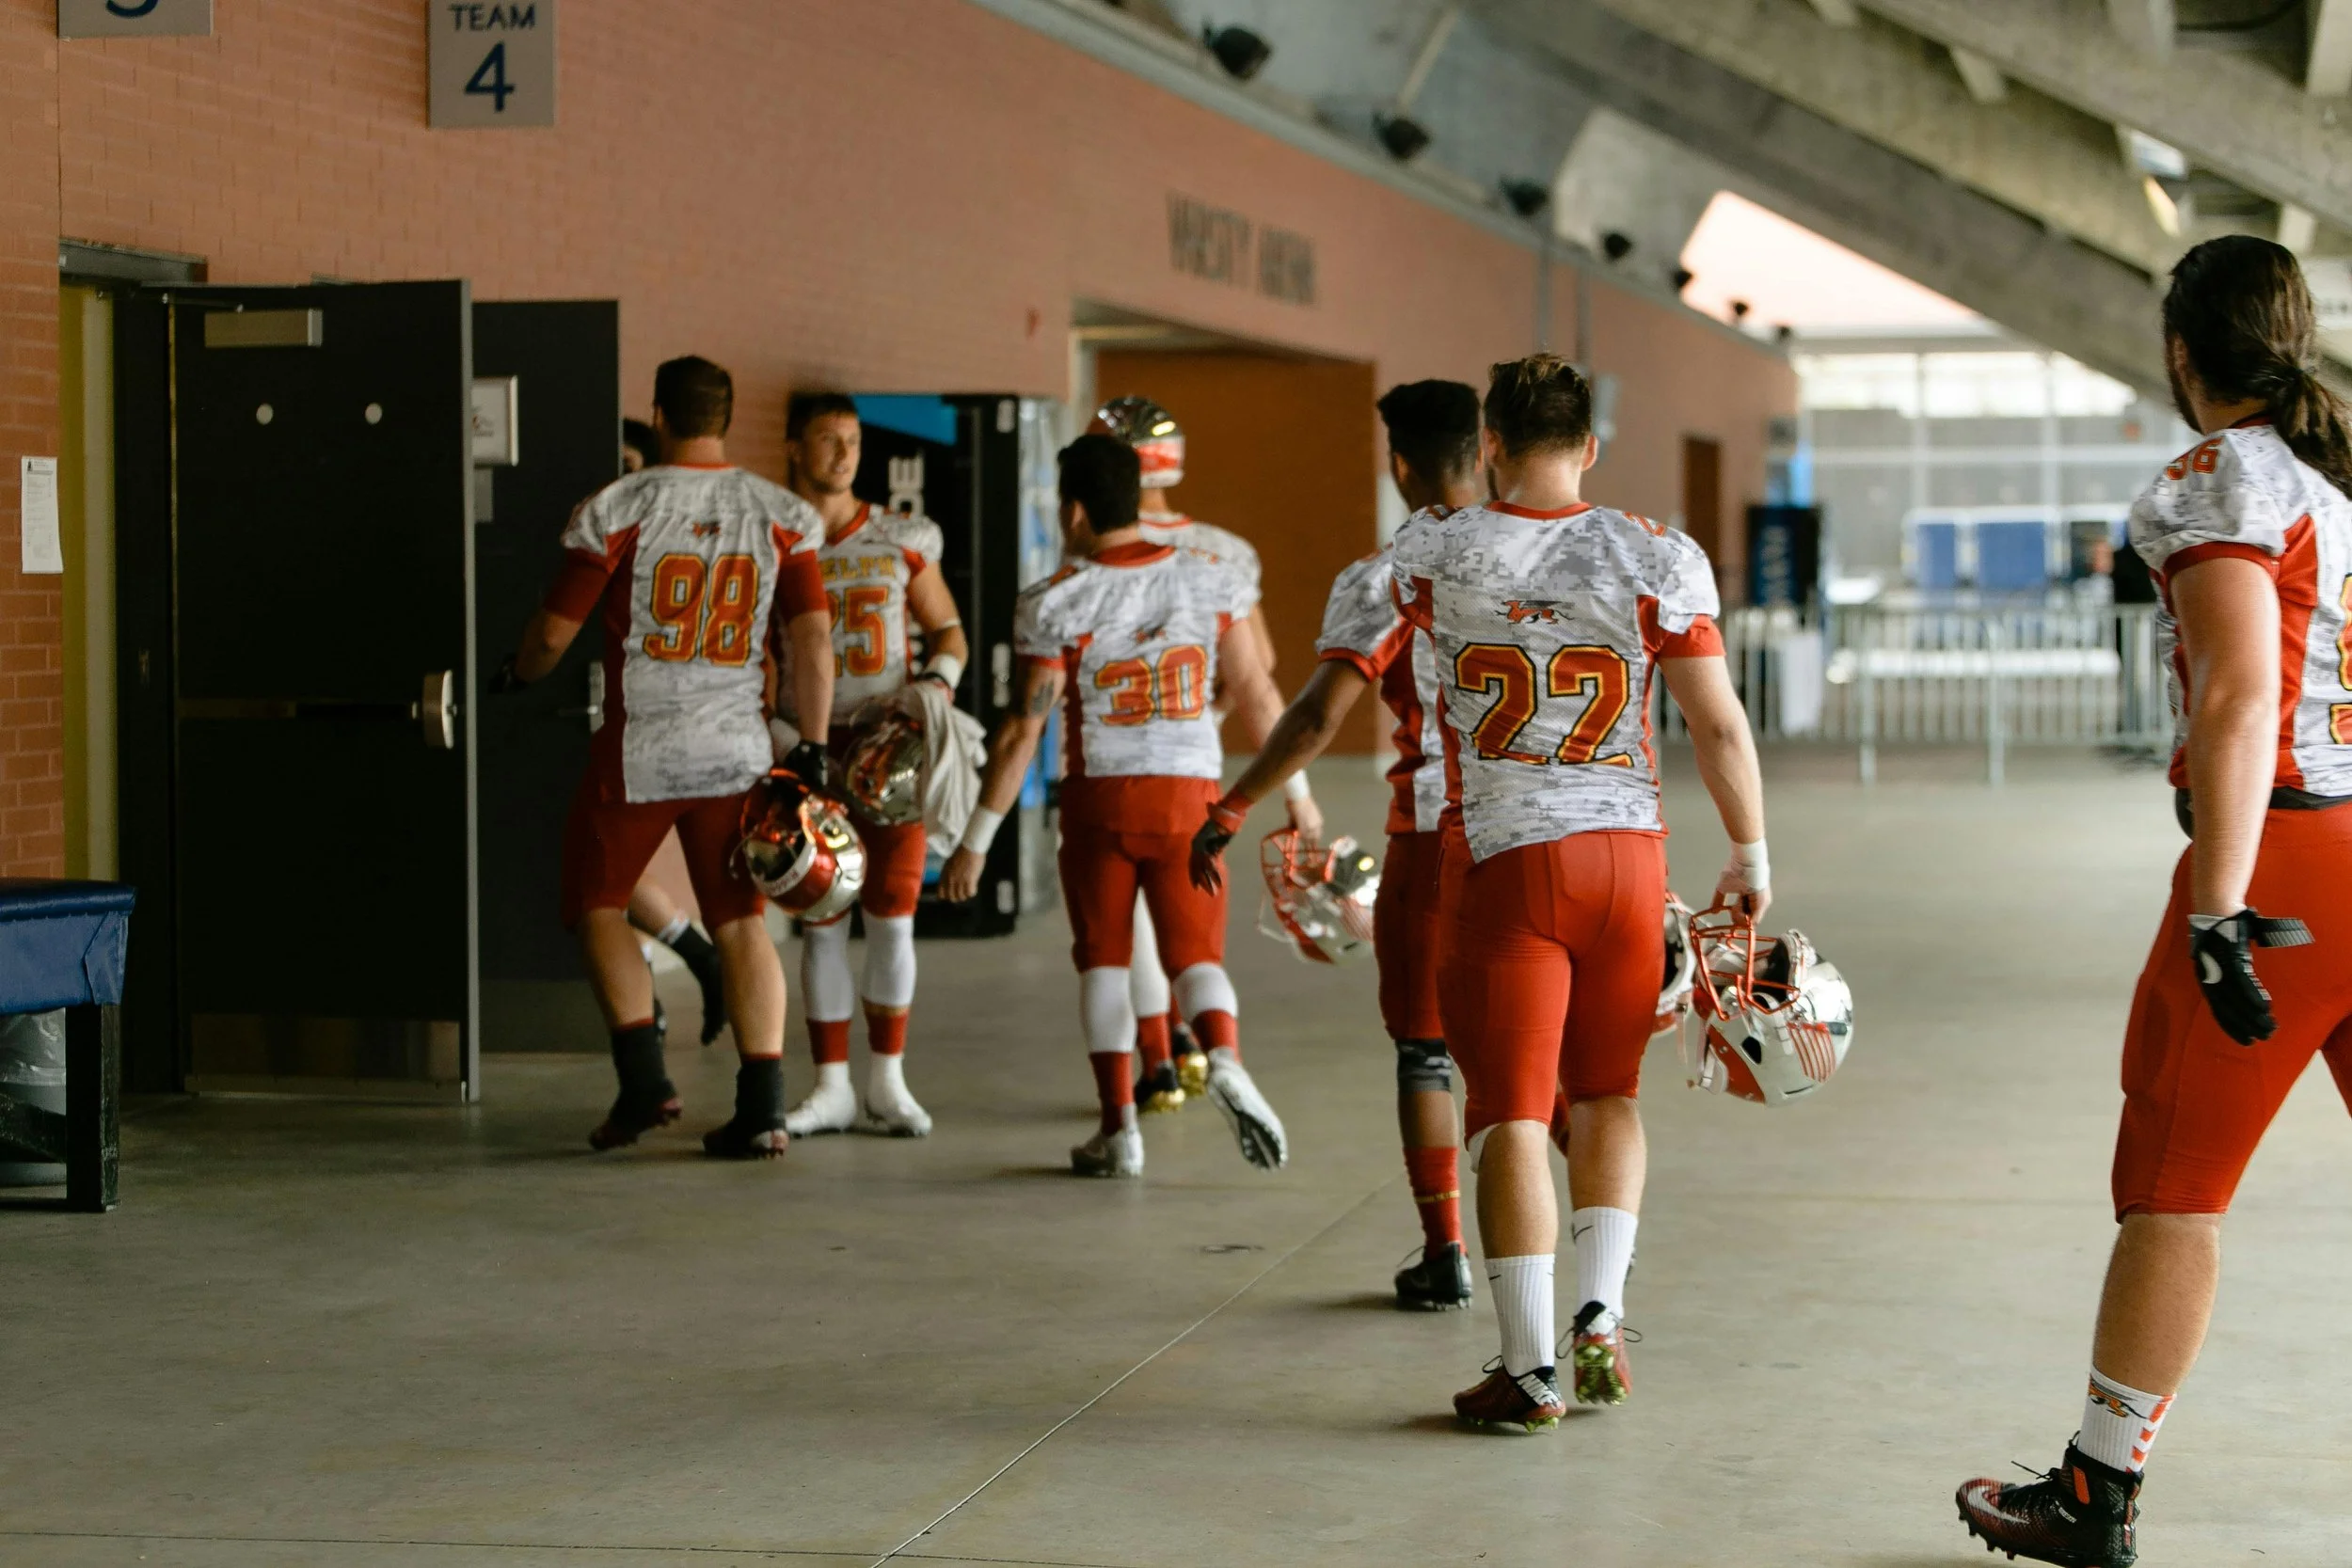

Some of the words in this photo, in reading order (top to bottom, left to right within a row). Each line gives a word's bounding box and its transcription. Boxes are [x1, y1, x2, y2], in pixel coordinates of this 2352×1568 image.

[448, 3, 536, 31] TEAM
[465, 41, 516, 113] 4
[820, 556, 898, 580] ELPH
[644, 553, 759, 668] 98
[1095, 644, 1208, 726] 30
[1454, 641, 1634, 768] 22
